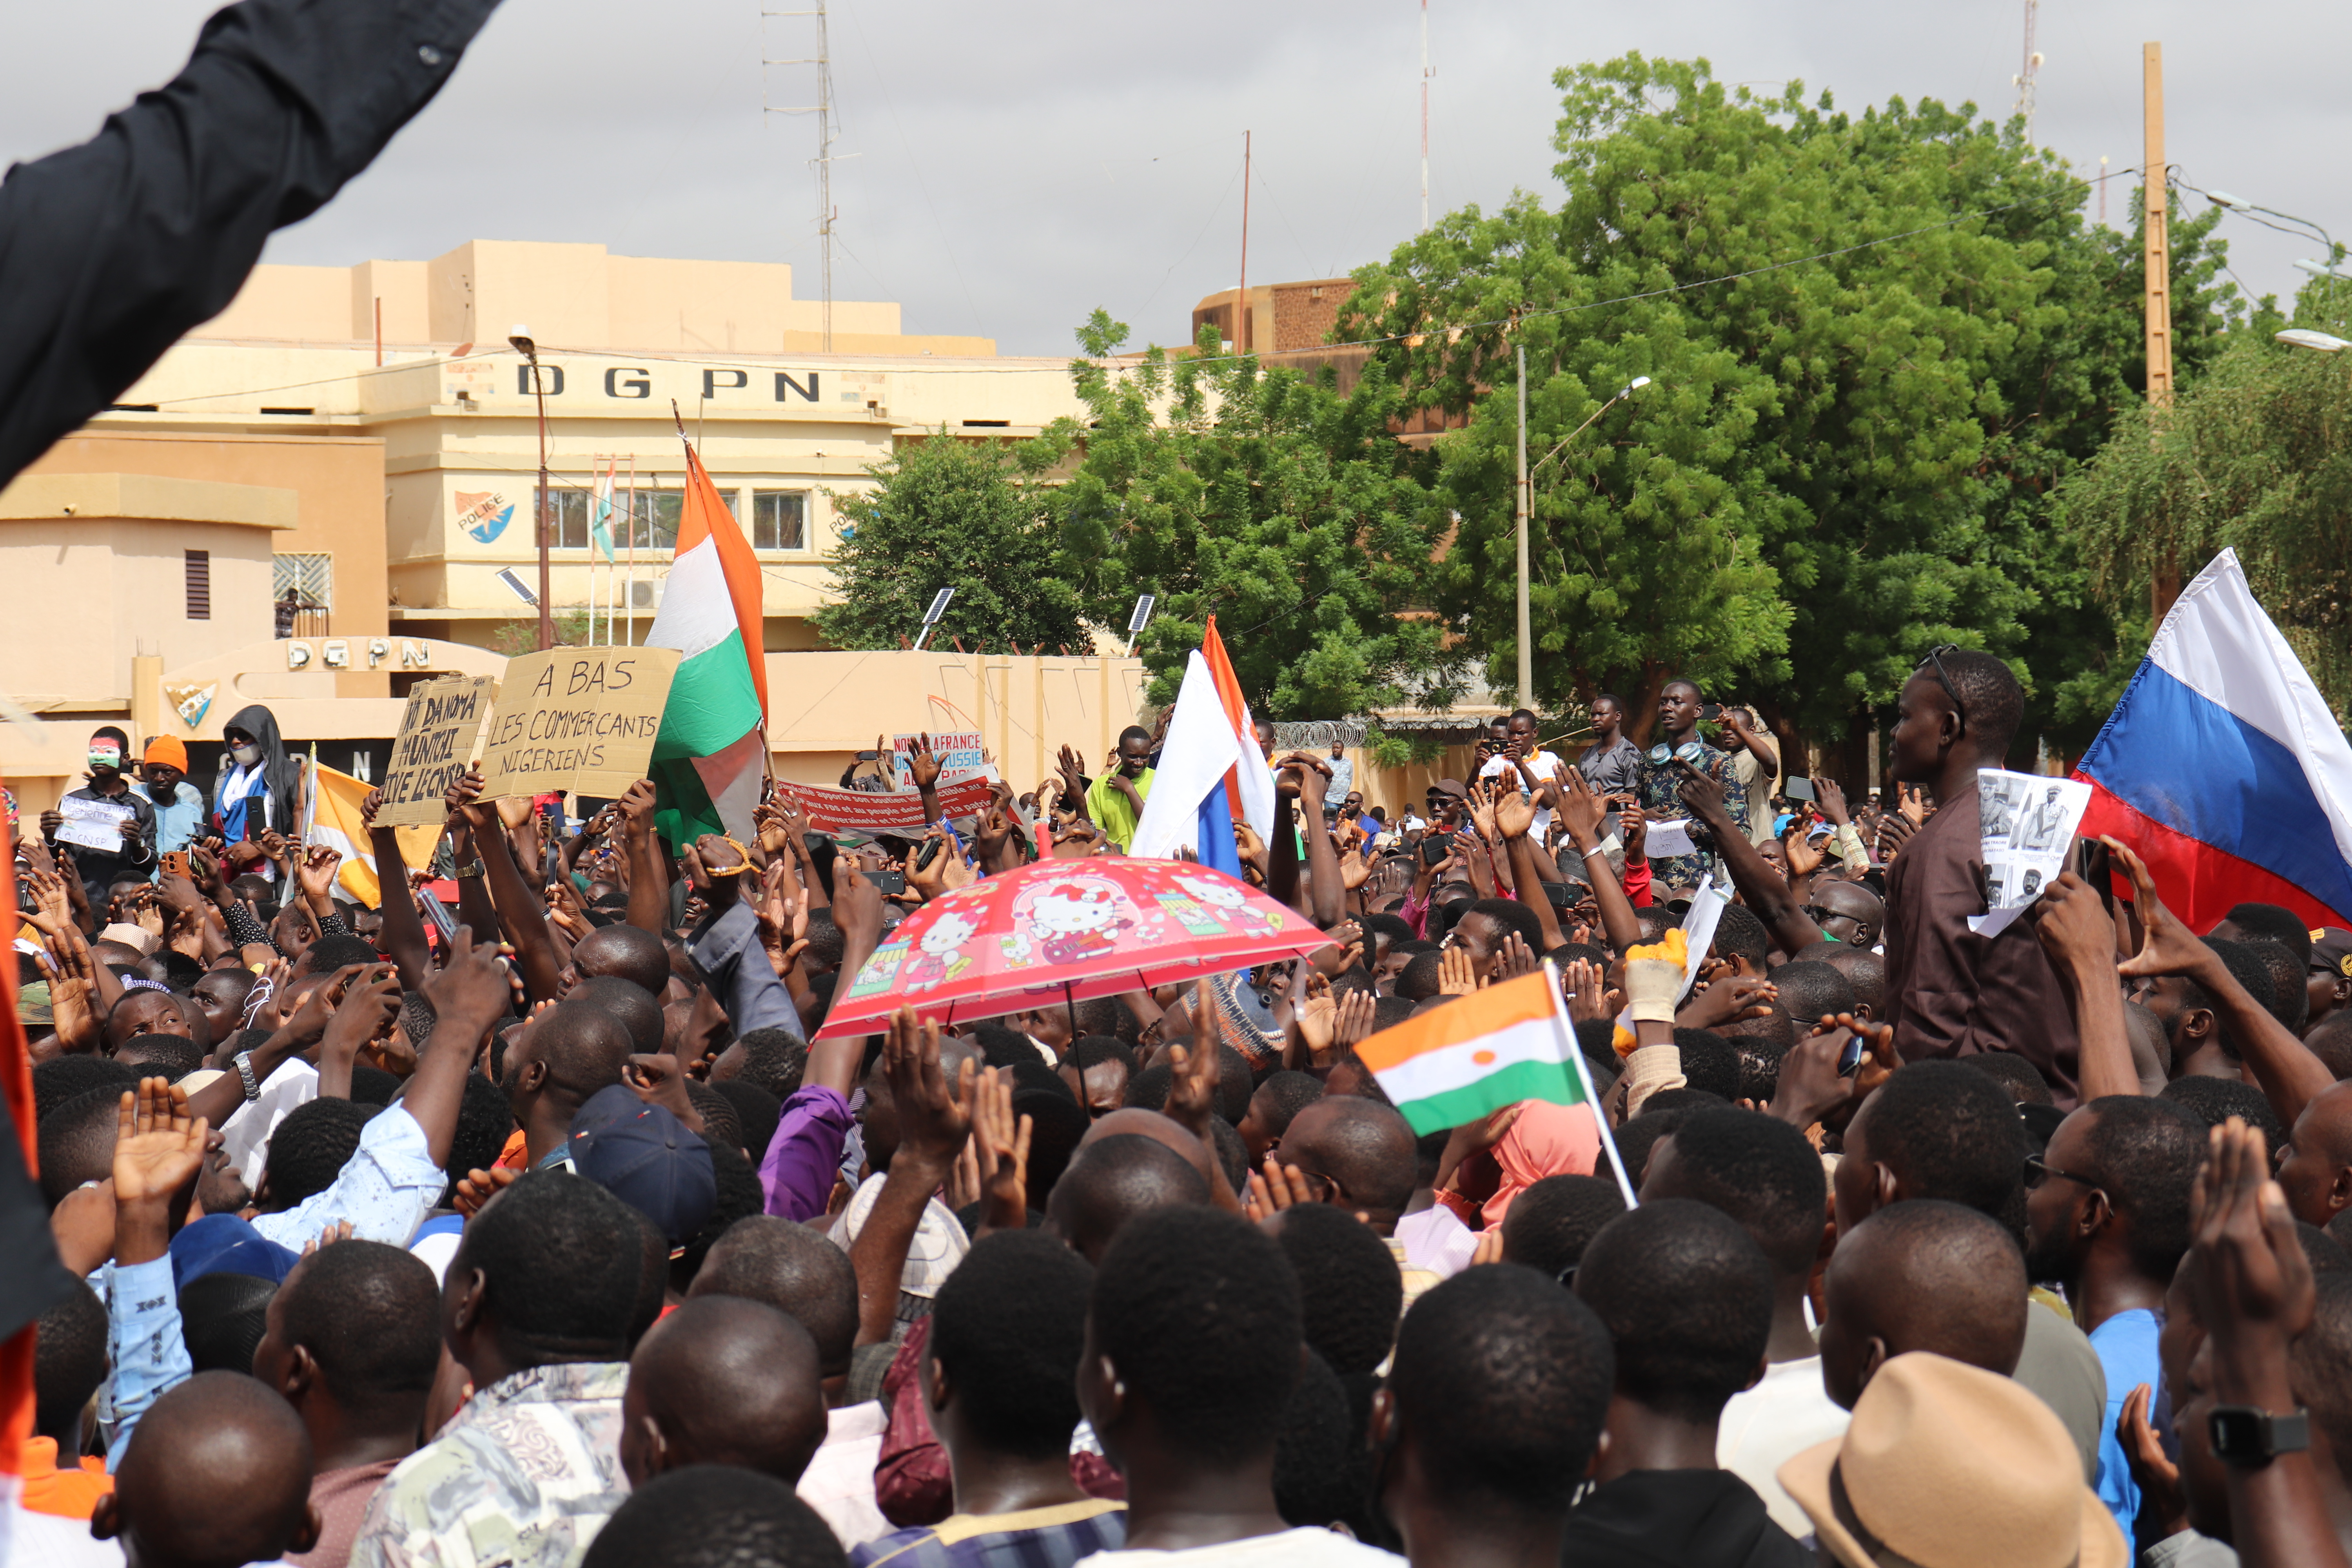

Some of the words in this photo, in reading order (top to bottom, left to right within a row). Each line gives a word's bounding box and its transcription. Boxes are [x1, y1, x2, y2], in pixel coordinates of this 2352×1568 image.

[457, 492, 505, 530] POLICE
[288, 639, 429, 668] DGPN
[532, 663, 554, 697] A
[567, 659, 635, 696] BAS
[489, 713, 526, 747] LES
[529, 709, 657, 741] COMMERÇANTS
[499, 743, 605, 778] NIGERIENS
[63, 796, 90, 808] VIVE
[815, 791, 852, 802] apporte
[870, 795, 907, 804] soutien
[906, 786, 967, 802] indctible
[967, 783, 982, 791] au
[807, 809, 819, 818] la
[819, 814, 878, 824] souveraineté
[889, 813, 926, 824] l'honne
[823, 804, 841, 812] FDS
[867, 808, 900, 816] peuple
[900, 805, 924, 813] debo
[77, 834, 109, 846] CNSP
